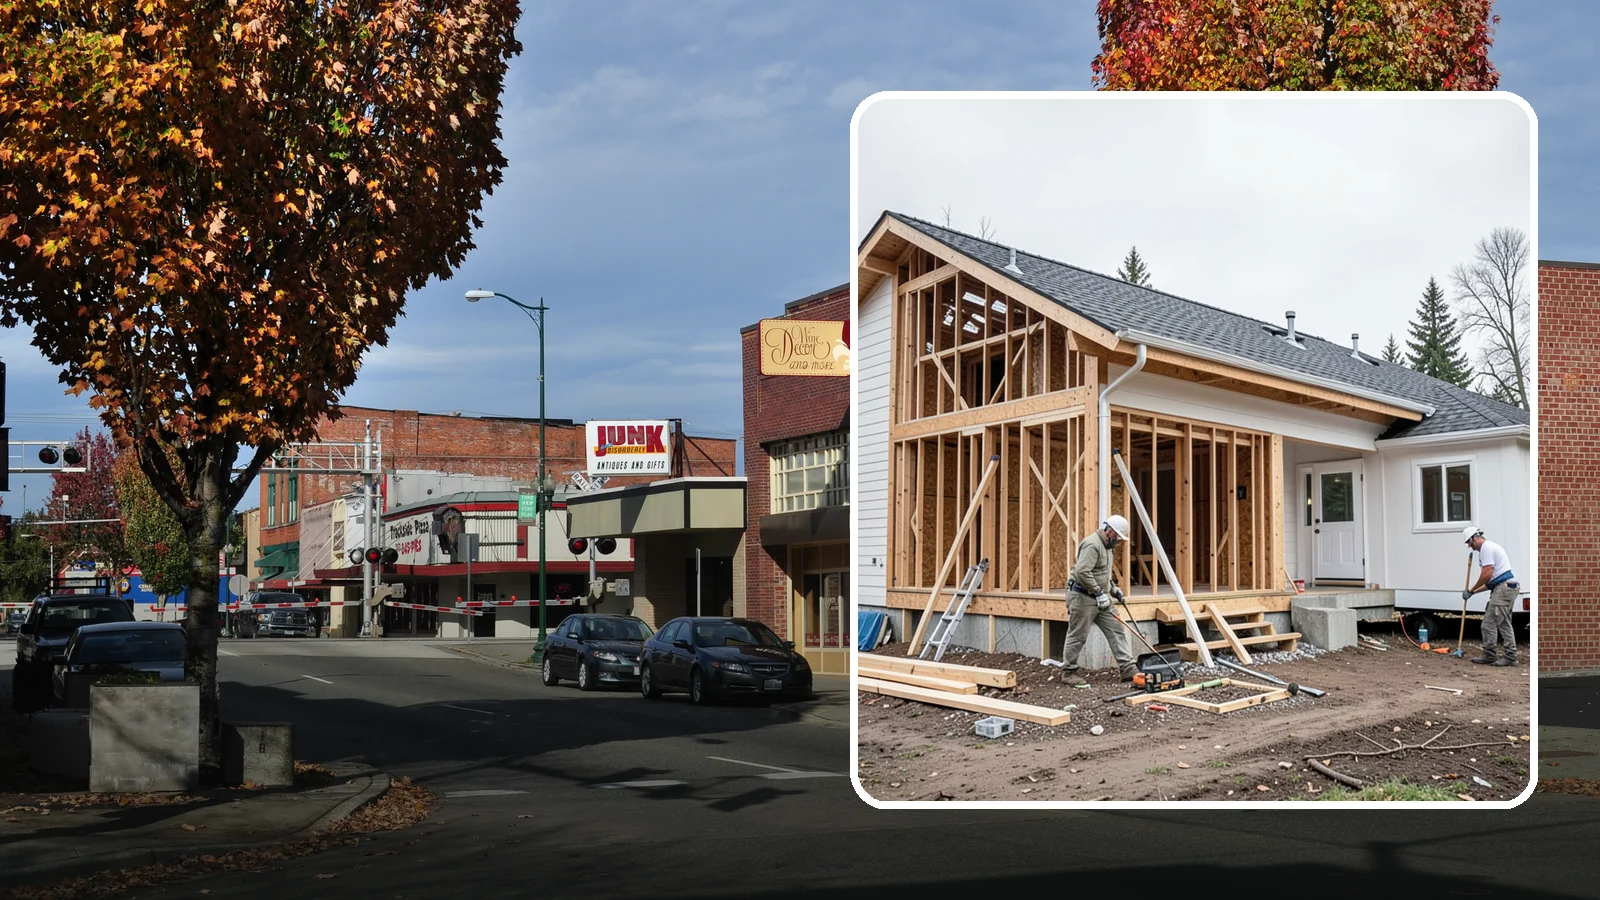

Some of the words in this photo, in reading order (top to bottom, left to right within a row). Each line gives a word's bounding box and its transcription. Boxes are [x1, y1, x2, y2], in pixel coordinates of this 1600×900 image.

[765, 327, 831, 365] Decor
[596, 425, 665, 457] JUNK
[607, 446, 646, 454] DISORDERLY
[597, 461, 628, 470] ANTIQUES
[631, 461, 643, 469] AND
[647, 460, 665, 469] GIFTS
[390, 521, 413, 540] Trackside
[414, 519, 429, 535] Pizza
